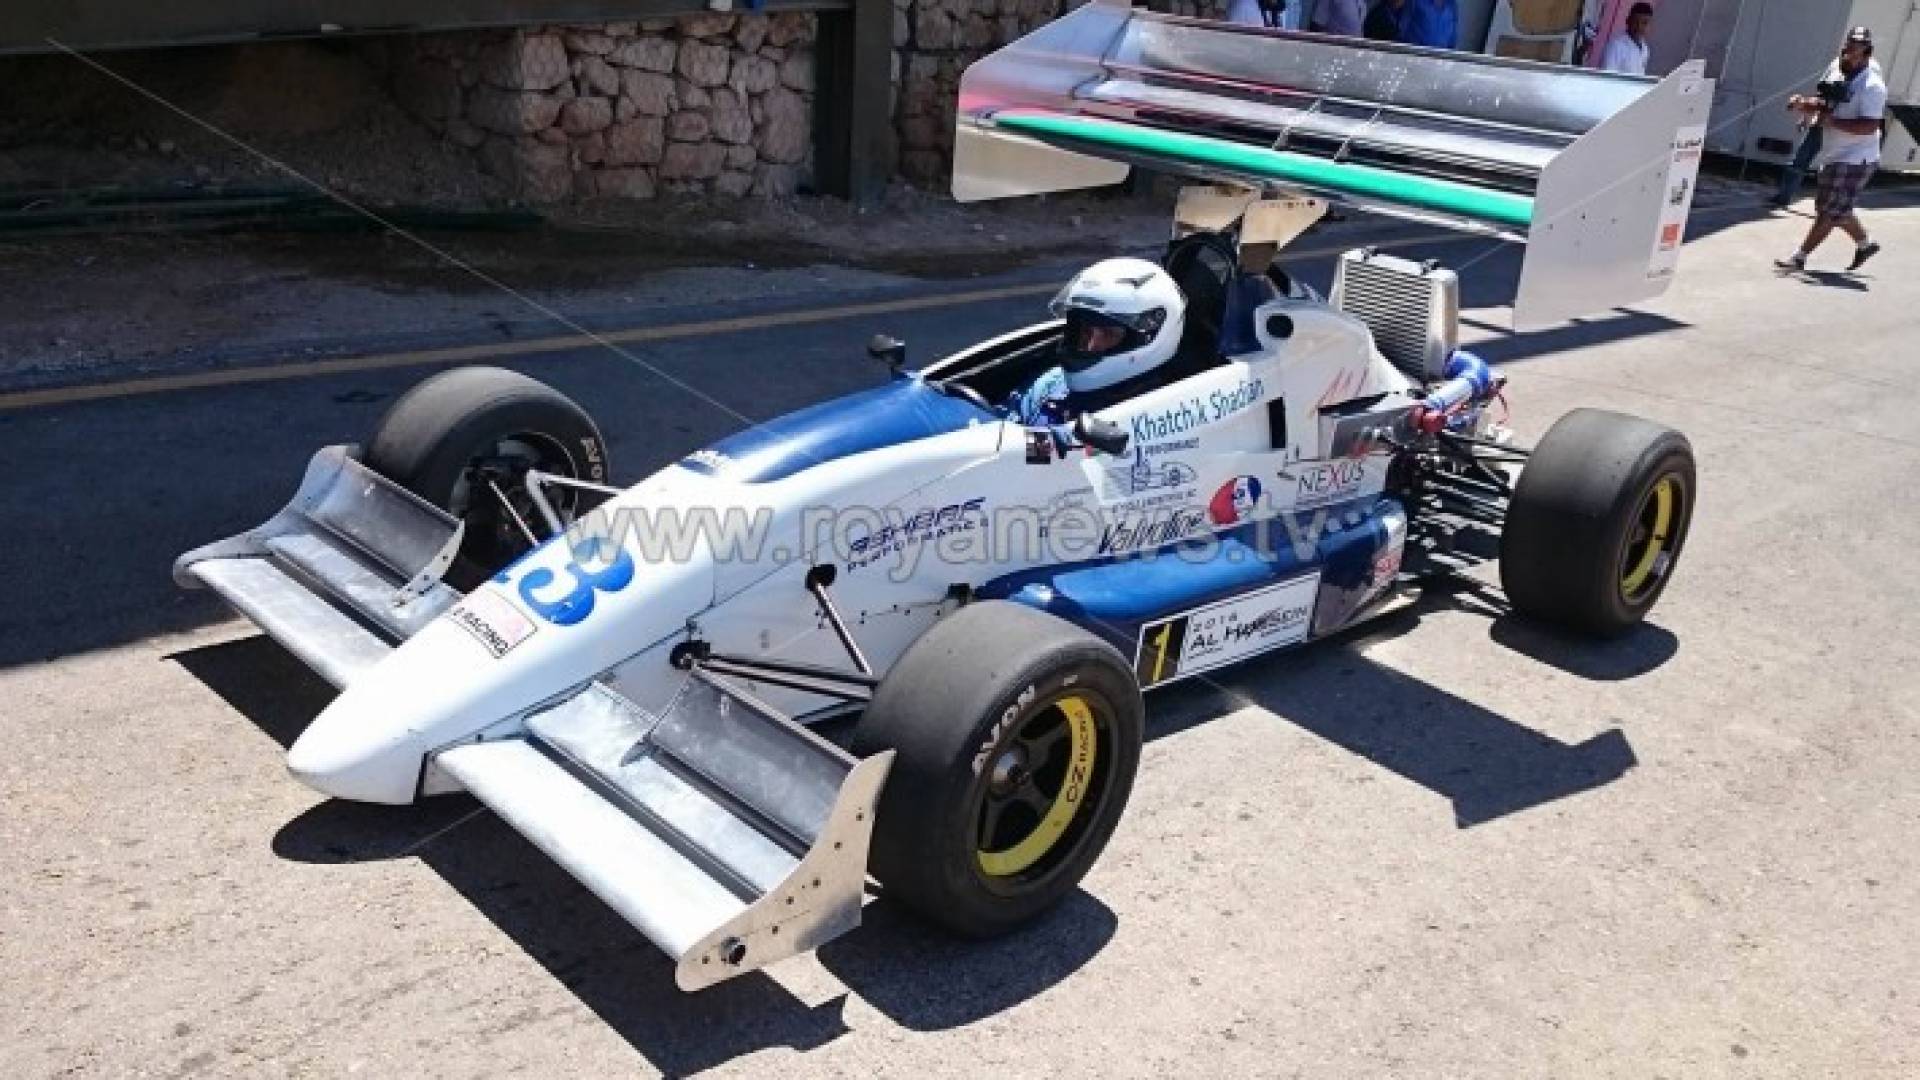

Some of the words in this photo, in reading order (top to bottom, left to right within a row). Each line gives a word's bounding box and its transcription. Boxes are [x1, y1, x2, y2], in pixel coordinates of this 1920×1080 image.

[1298, 461, 1365, 494] NEXUS
[1151, 621, 1172, 684] 1
[971, 684, 1036, 776] AVON
